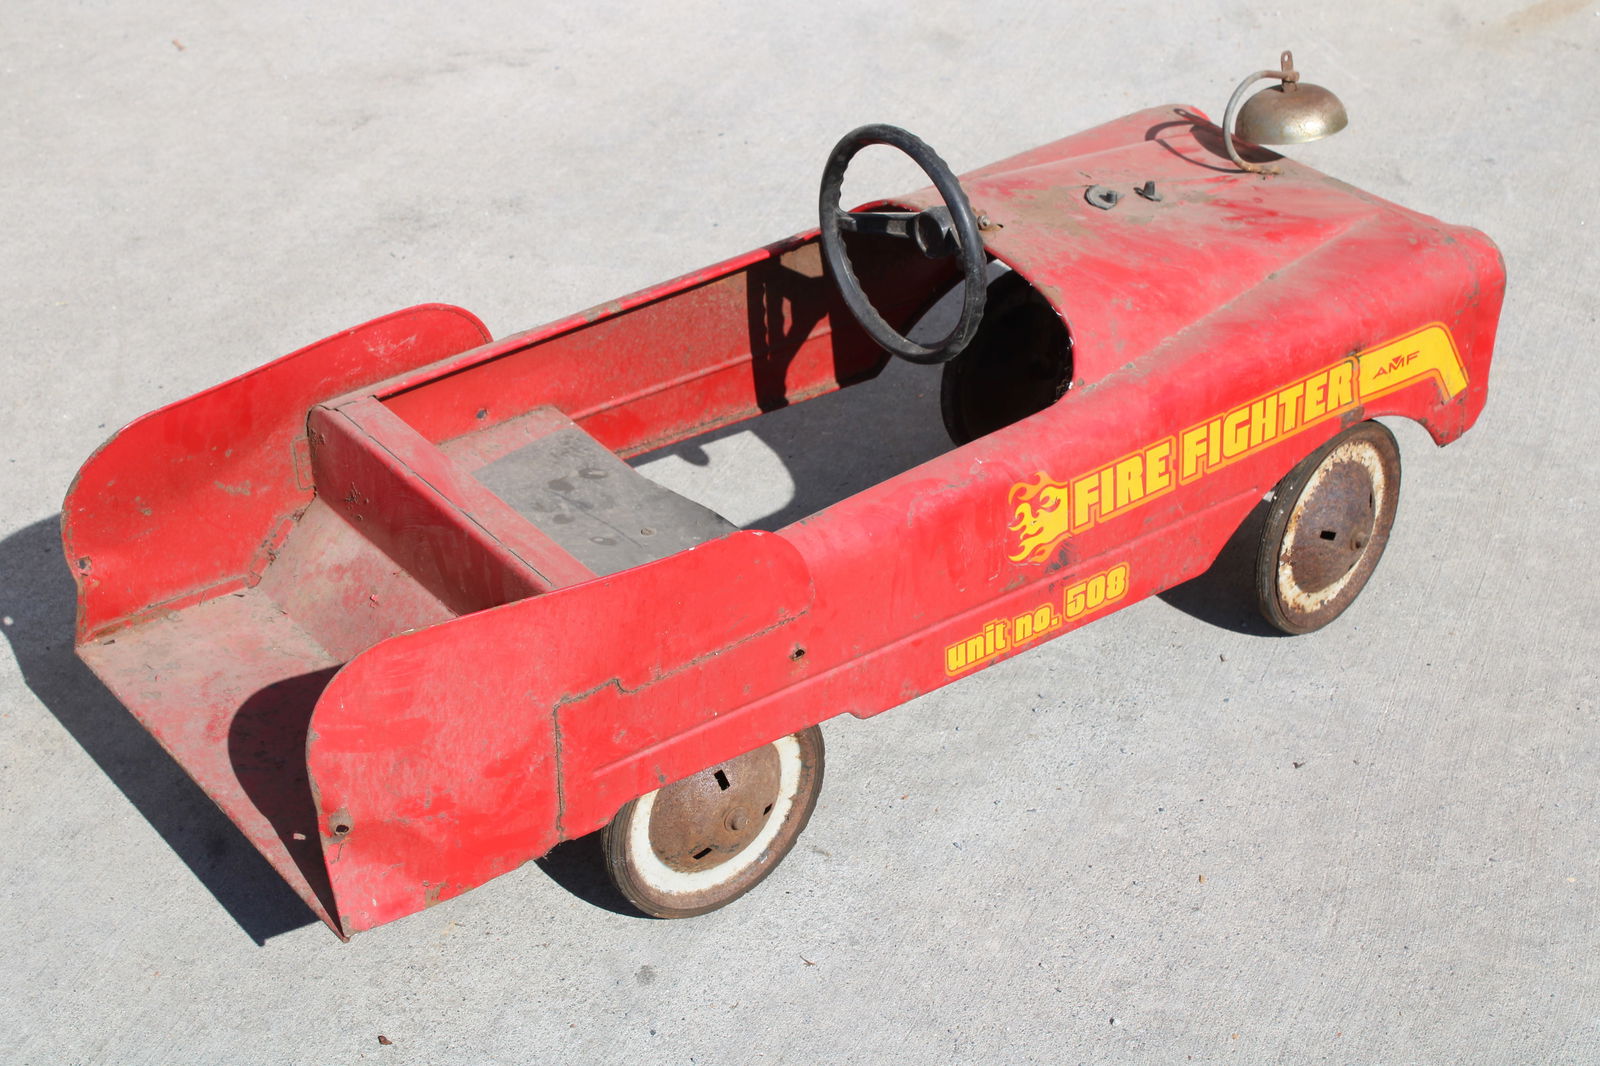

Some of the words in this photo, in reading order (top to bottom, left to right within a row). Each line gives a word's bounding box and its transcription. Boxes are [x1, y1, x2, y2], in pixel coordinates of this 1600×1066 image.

[1372, 350, 1420, 380] AMF
[1072, 439, 1172, 529] FIRE
[1181, 360, 1355, 480] FIGHTER
[946, 621, 1008, 672] unit
[1015, 605, 1060, 643] no.
[1065, 564, 1127, 619] 508
